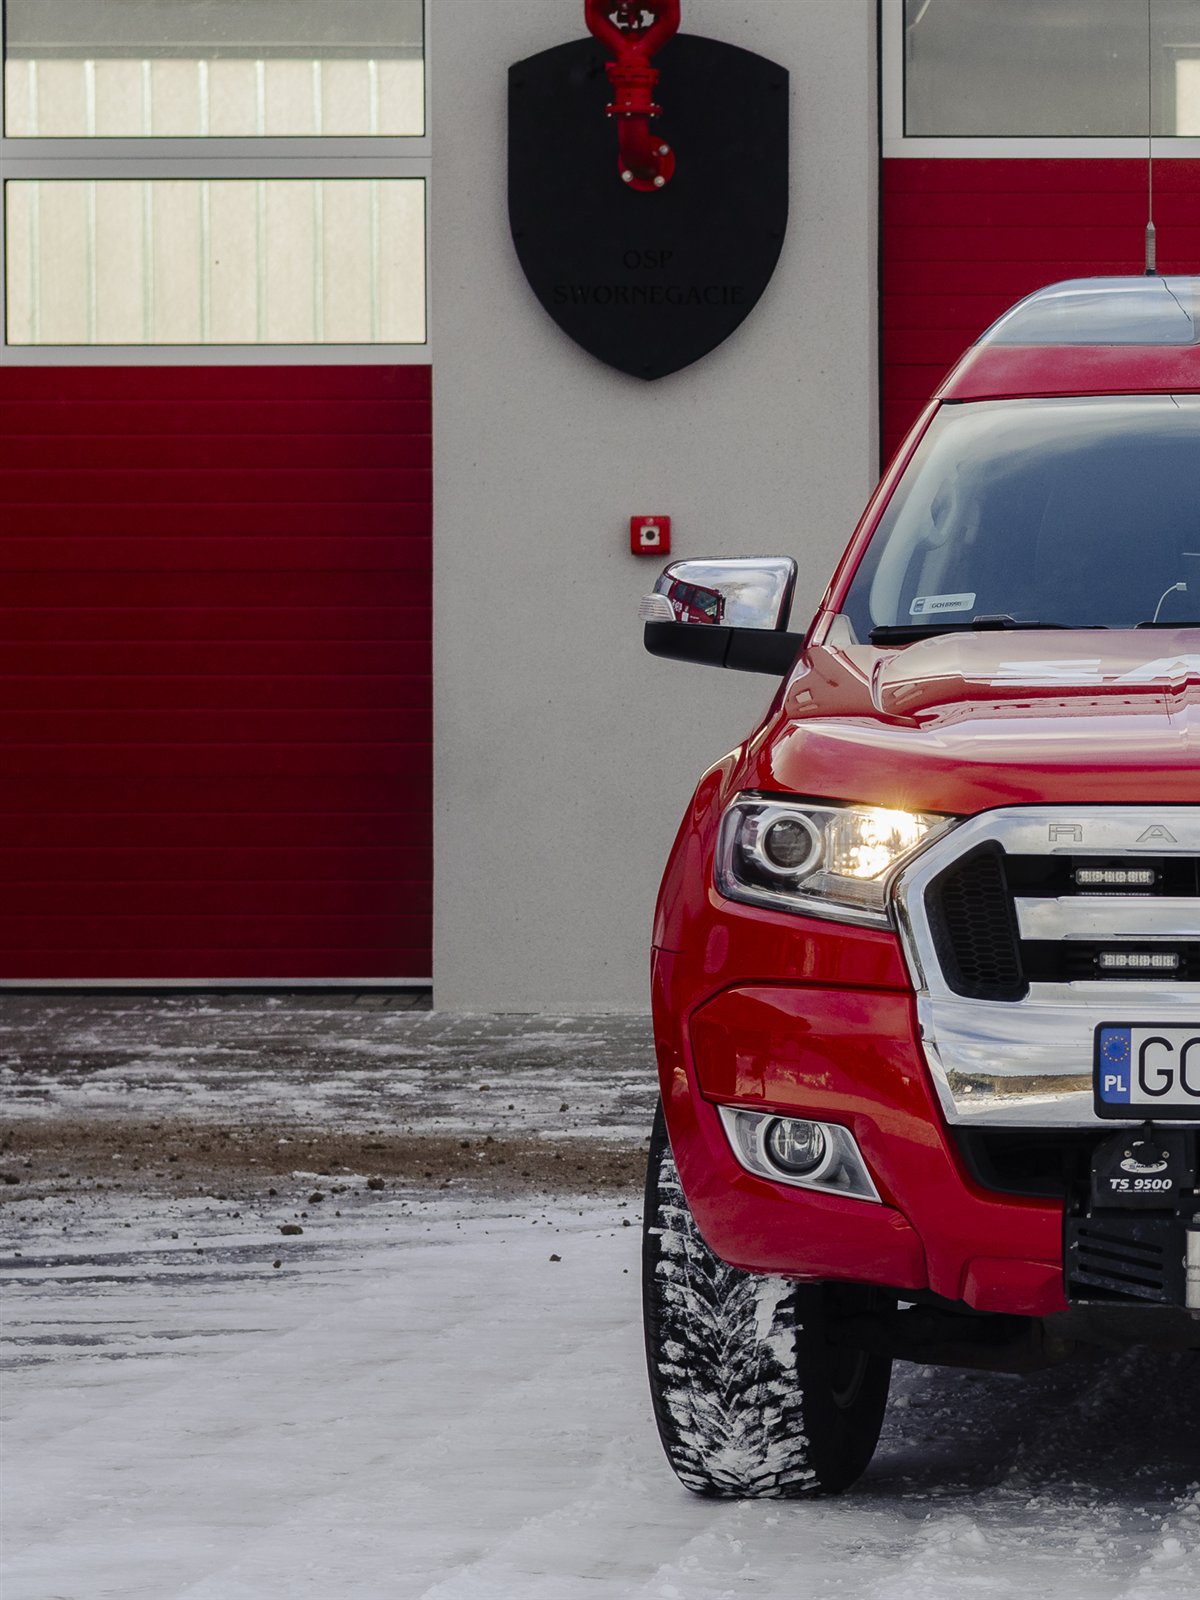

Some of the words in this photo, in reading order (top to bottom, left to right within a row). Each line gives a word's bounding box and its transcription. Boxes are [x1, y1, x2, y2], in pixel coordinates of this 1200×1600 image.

[622, 249, 673, 270] OSP
[553, 285, 745, 305] SWORNEGACIE
[1104, 1075, 1127, 1092] PL
[1109, 1179, 1130, 1190] TS
[1134, 1179, 1173, 1190] 9500
